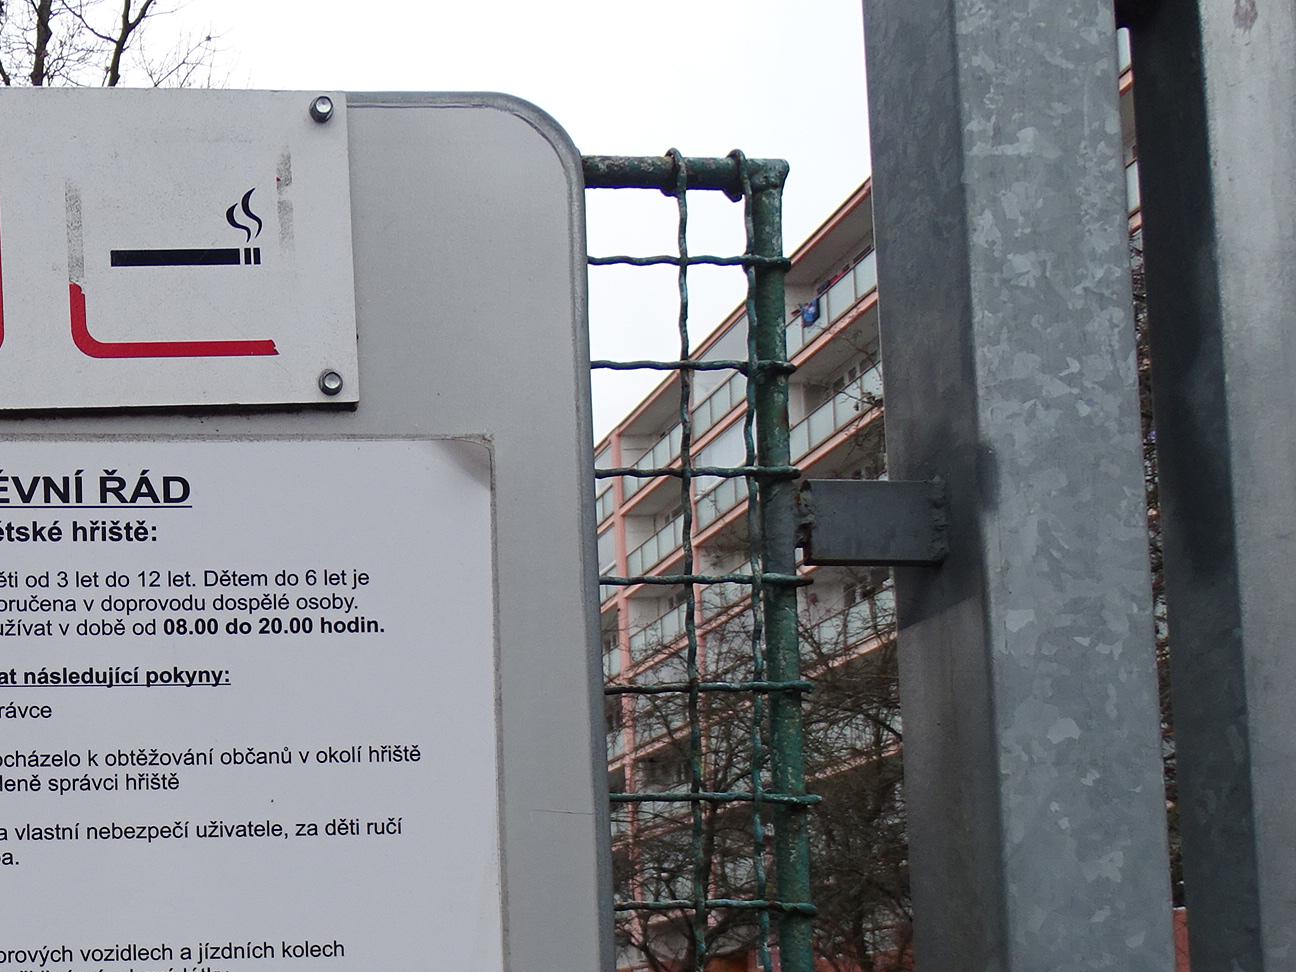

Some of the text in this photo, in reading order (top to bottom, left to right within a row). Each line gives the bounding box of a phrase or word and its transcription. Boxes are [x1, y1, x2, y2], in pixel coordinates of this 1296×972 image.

[99, 468, 191, 504] ŘÁD
[72, 520, 157, 542] hřiště:
[82, 599, 95, 612] v
[100, 594, 206, 616] doprovodu
[212, 593, 290, 615] dospělé
[296, 592, 358, 614] osoby.
[58, 623, 70, 637] v
[76, 618, 126, 636] době
[132, 618, 157, 636] od
[163, 617, 219, 636] 08.00
[225, 617, 252, 635] do
[258, 616, 313, 635] 20.00
[320, 616, 385, 634] hodin.
[24, 666, 140, 689] následující
[145, 666, 230, 688] pokyny:
[48, 773, 118, 796] správci
[125, 772, 180, 791] hřiště
